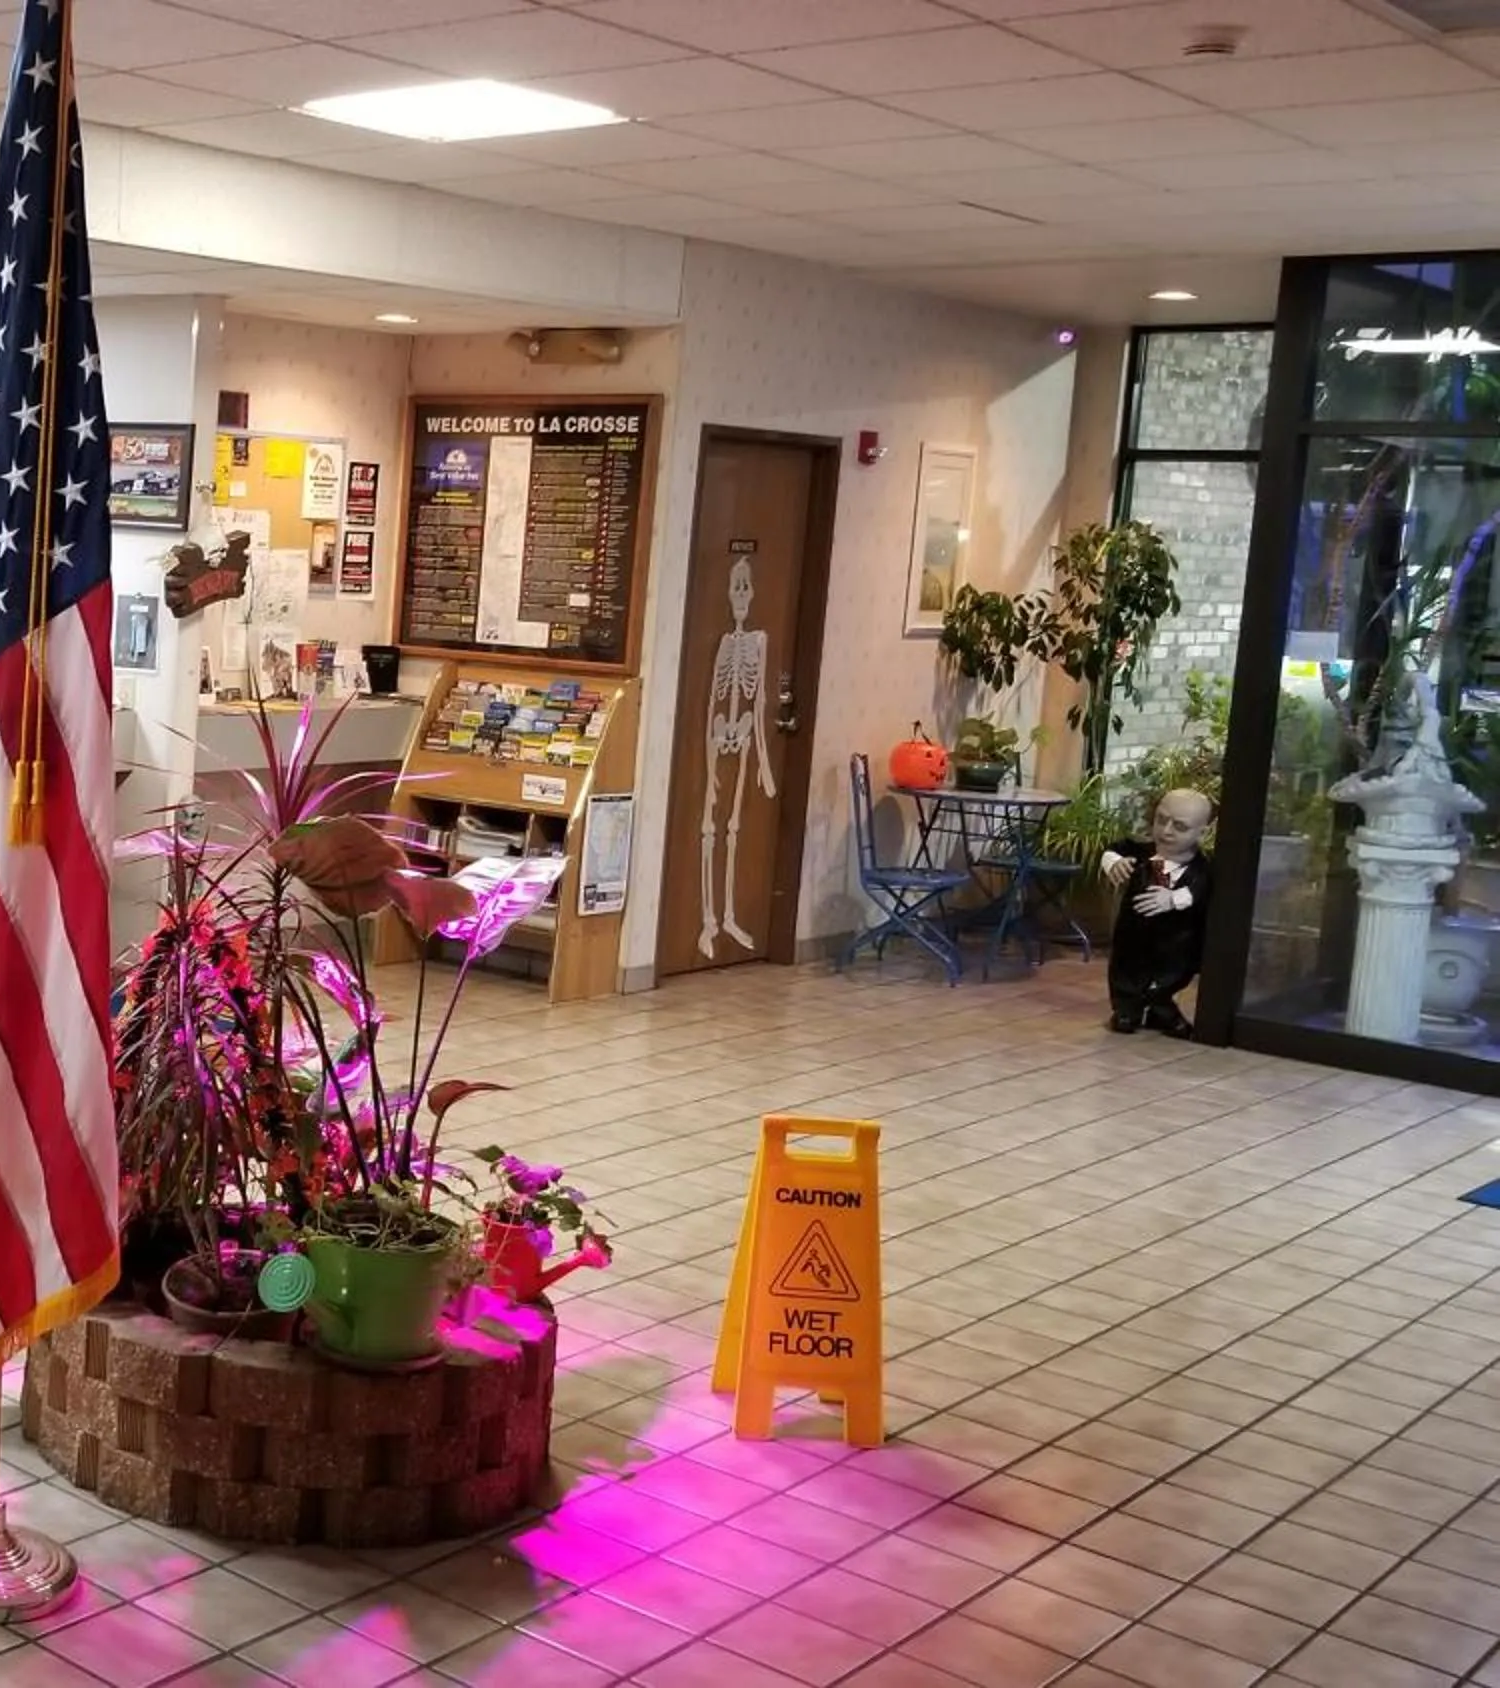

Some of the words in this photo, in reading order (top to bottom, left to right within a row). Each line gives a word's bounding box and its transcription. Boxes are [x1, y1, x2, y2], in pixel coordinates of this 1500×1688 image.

[426, 416, 511, 433] WELCOME
[514, 417, 535, 433] TO
[538, 416, 561, 433] LA
[564, 416, 639, 433] CROSSE
[775, 1187, 861, 1208] CAUTION
[784, 1308, 843, 1332] WET
[768, 1332, 854, 1358] FLOOR
